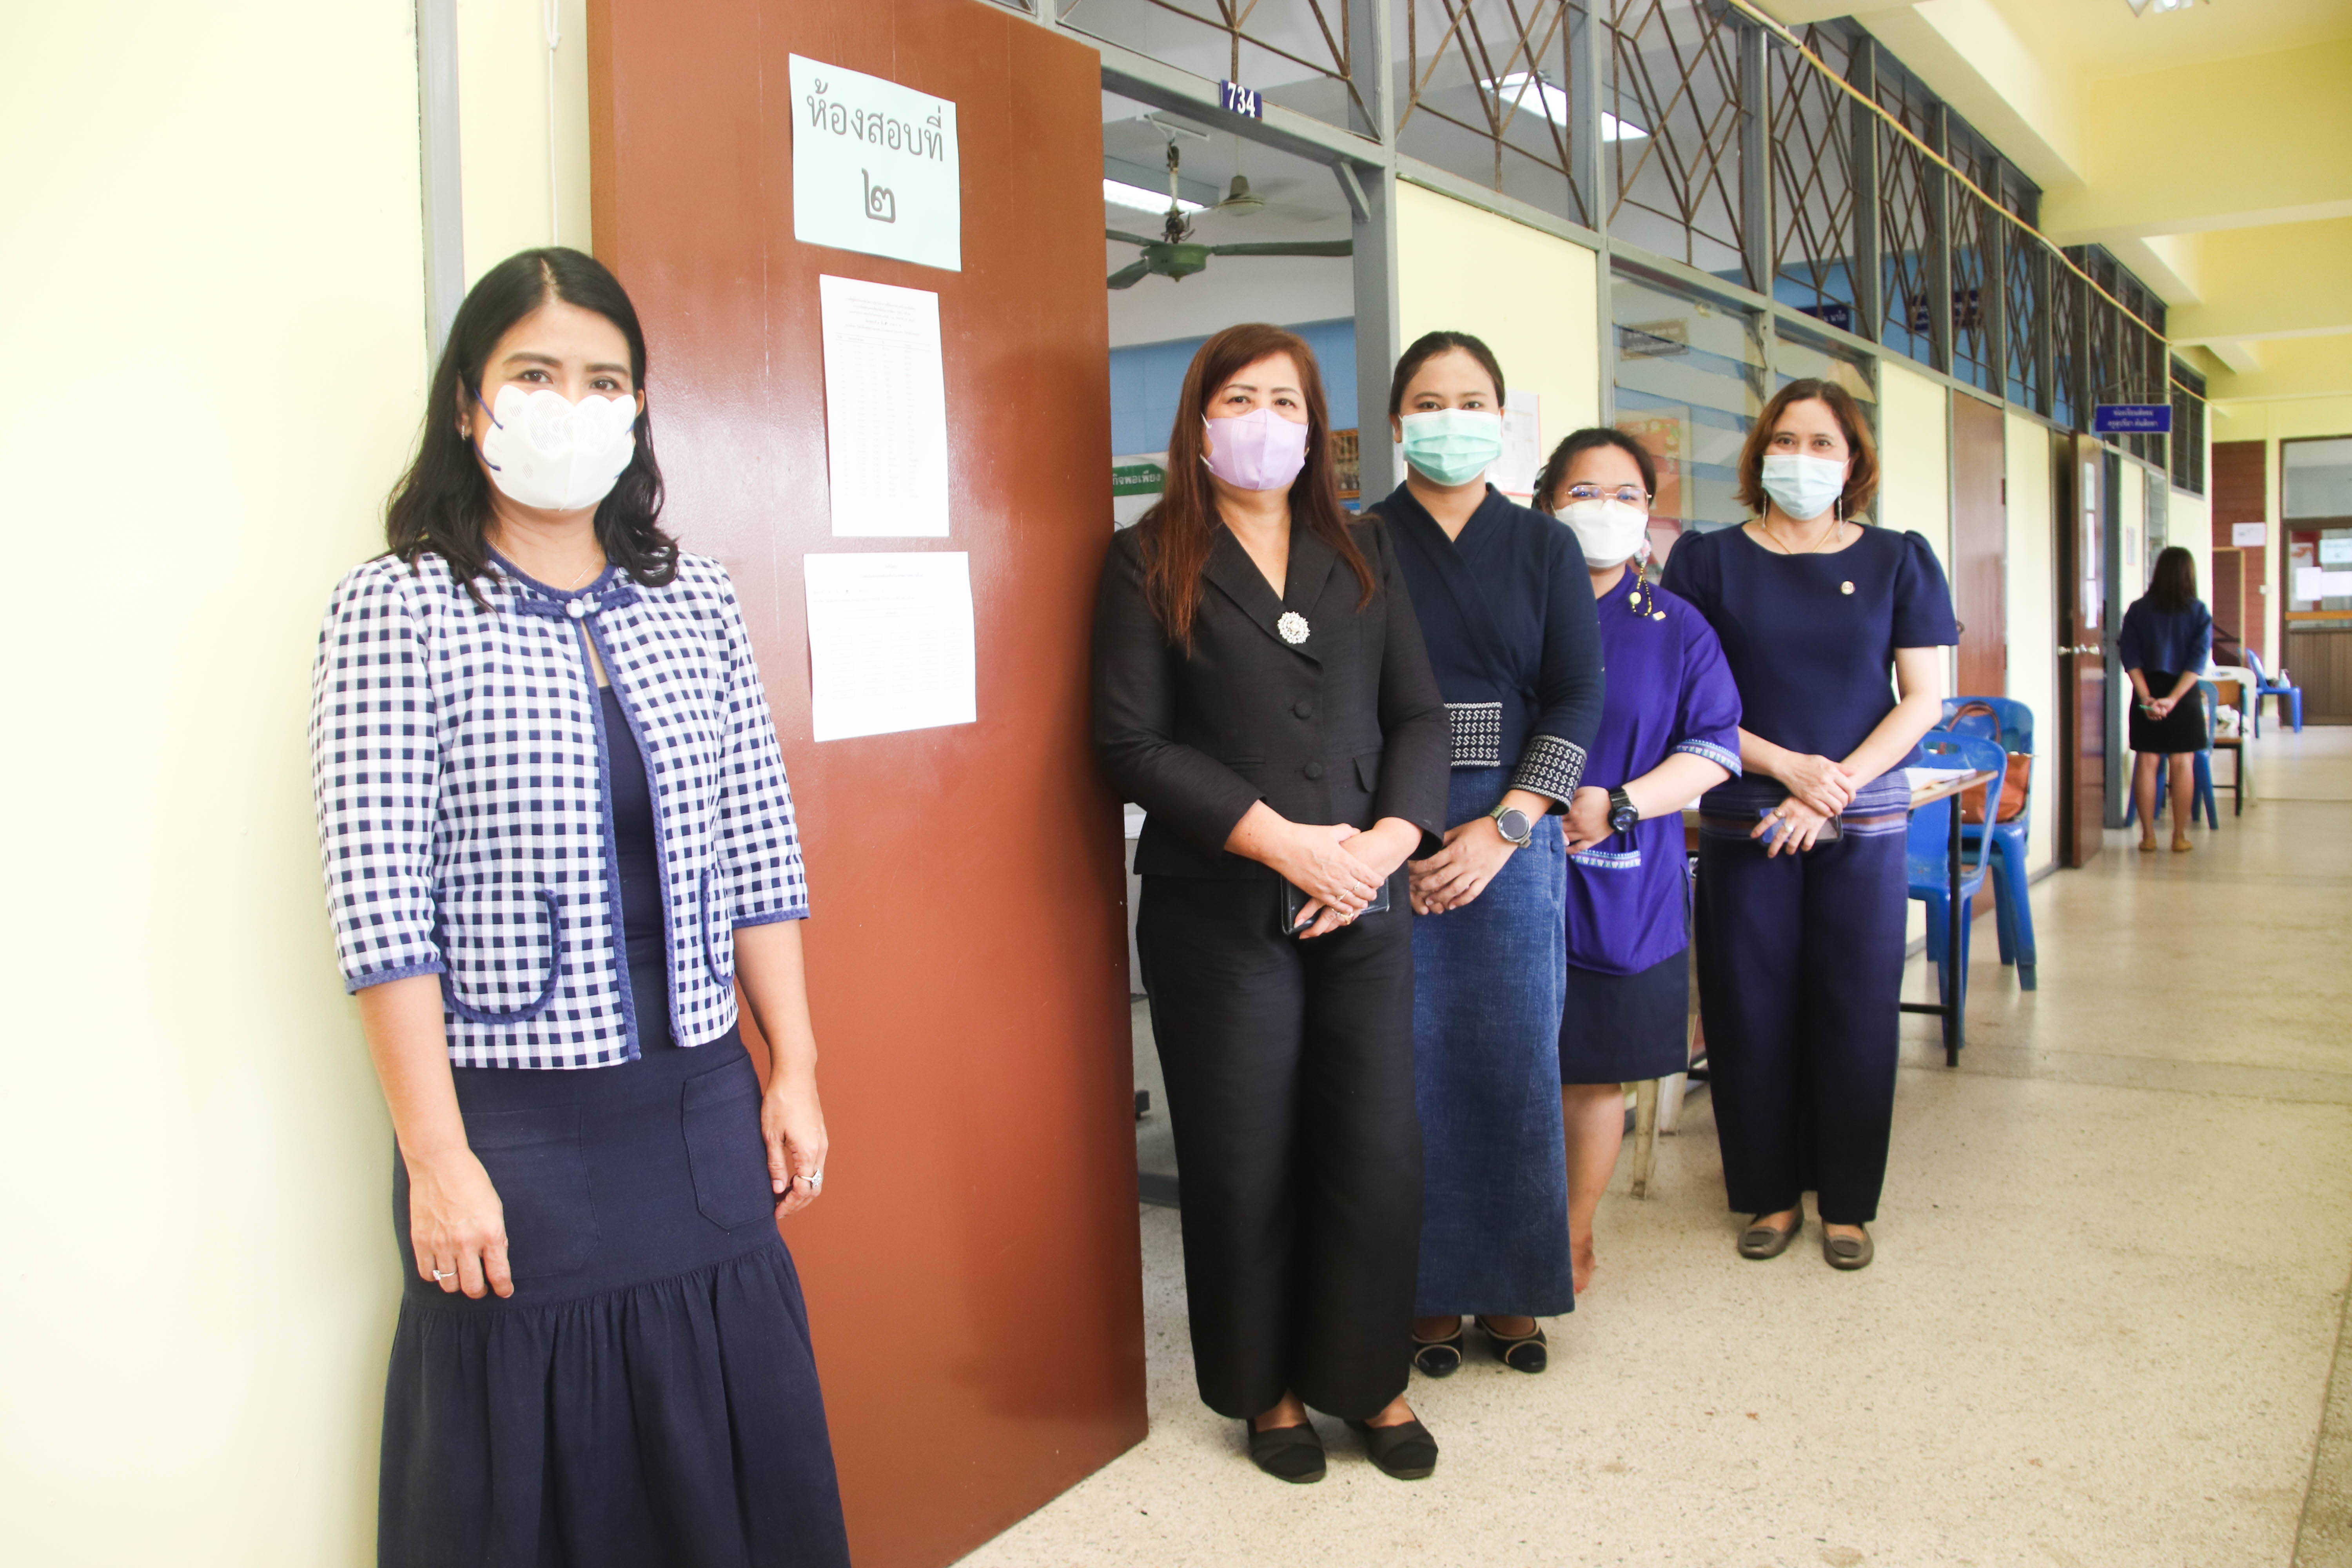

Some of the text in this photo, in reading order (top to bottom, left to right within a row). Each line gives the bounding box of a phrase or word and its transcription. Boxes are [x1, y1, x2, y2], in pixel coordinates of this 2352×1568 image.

[806, 78, 944, 162] ห้องสอบที่
[1227, 82, 1256, 118] 734
[861, 167, 896, 224] ๒
